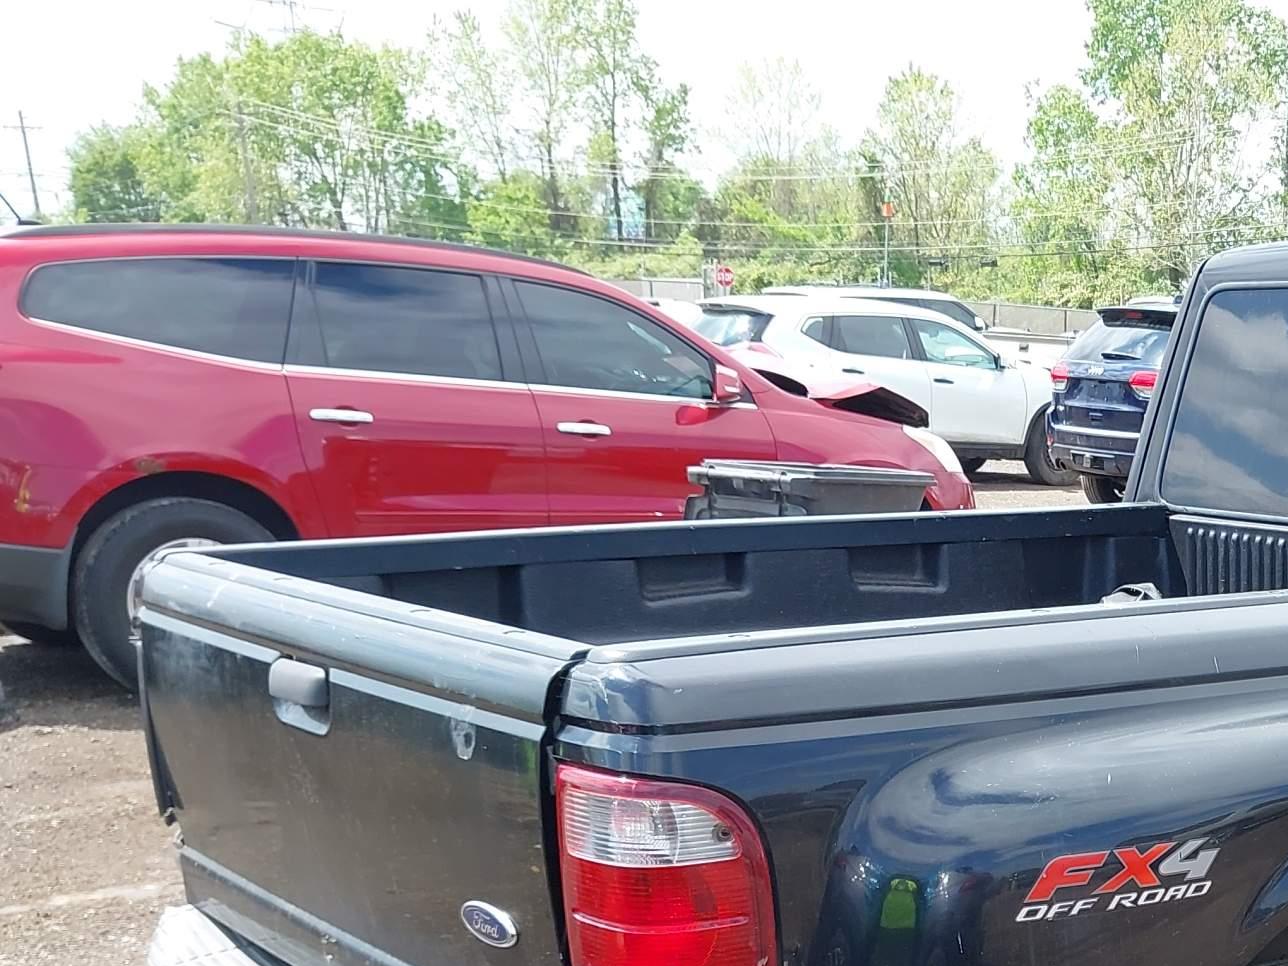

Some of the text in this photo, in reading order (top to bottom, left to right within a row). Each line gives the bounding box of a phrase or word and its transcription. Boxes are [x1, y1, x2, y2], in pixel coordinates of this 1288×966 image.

[1024, 837, 1221, 903] FX4
[1015, 880, 1212, 922] OFF ROAD
[472, 910, 500, 939] Ford
